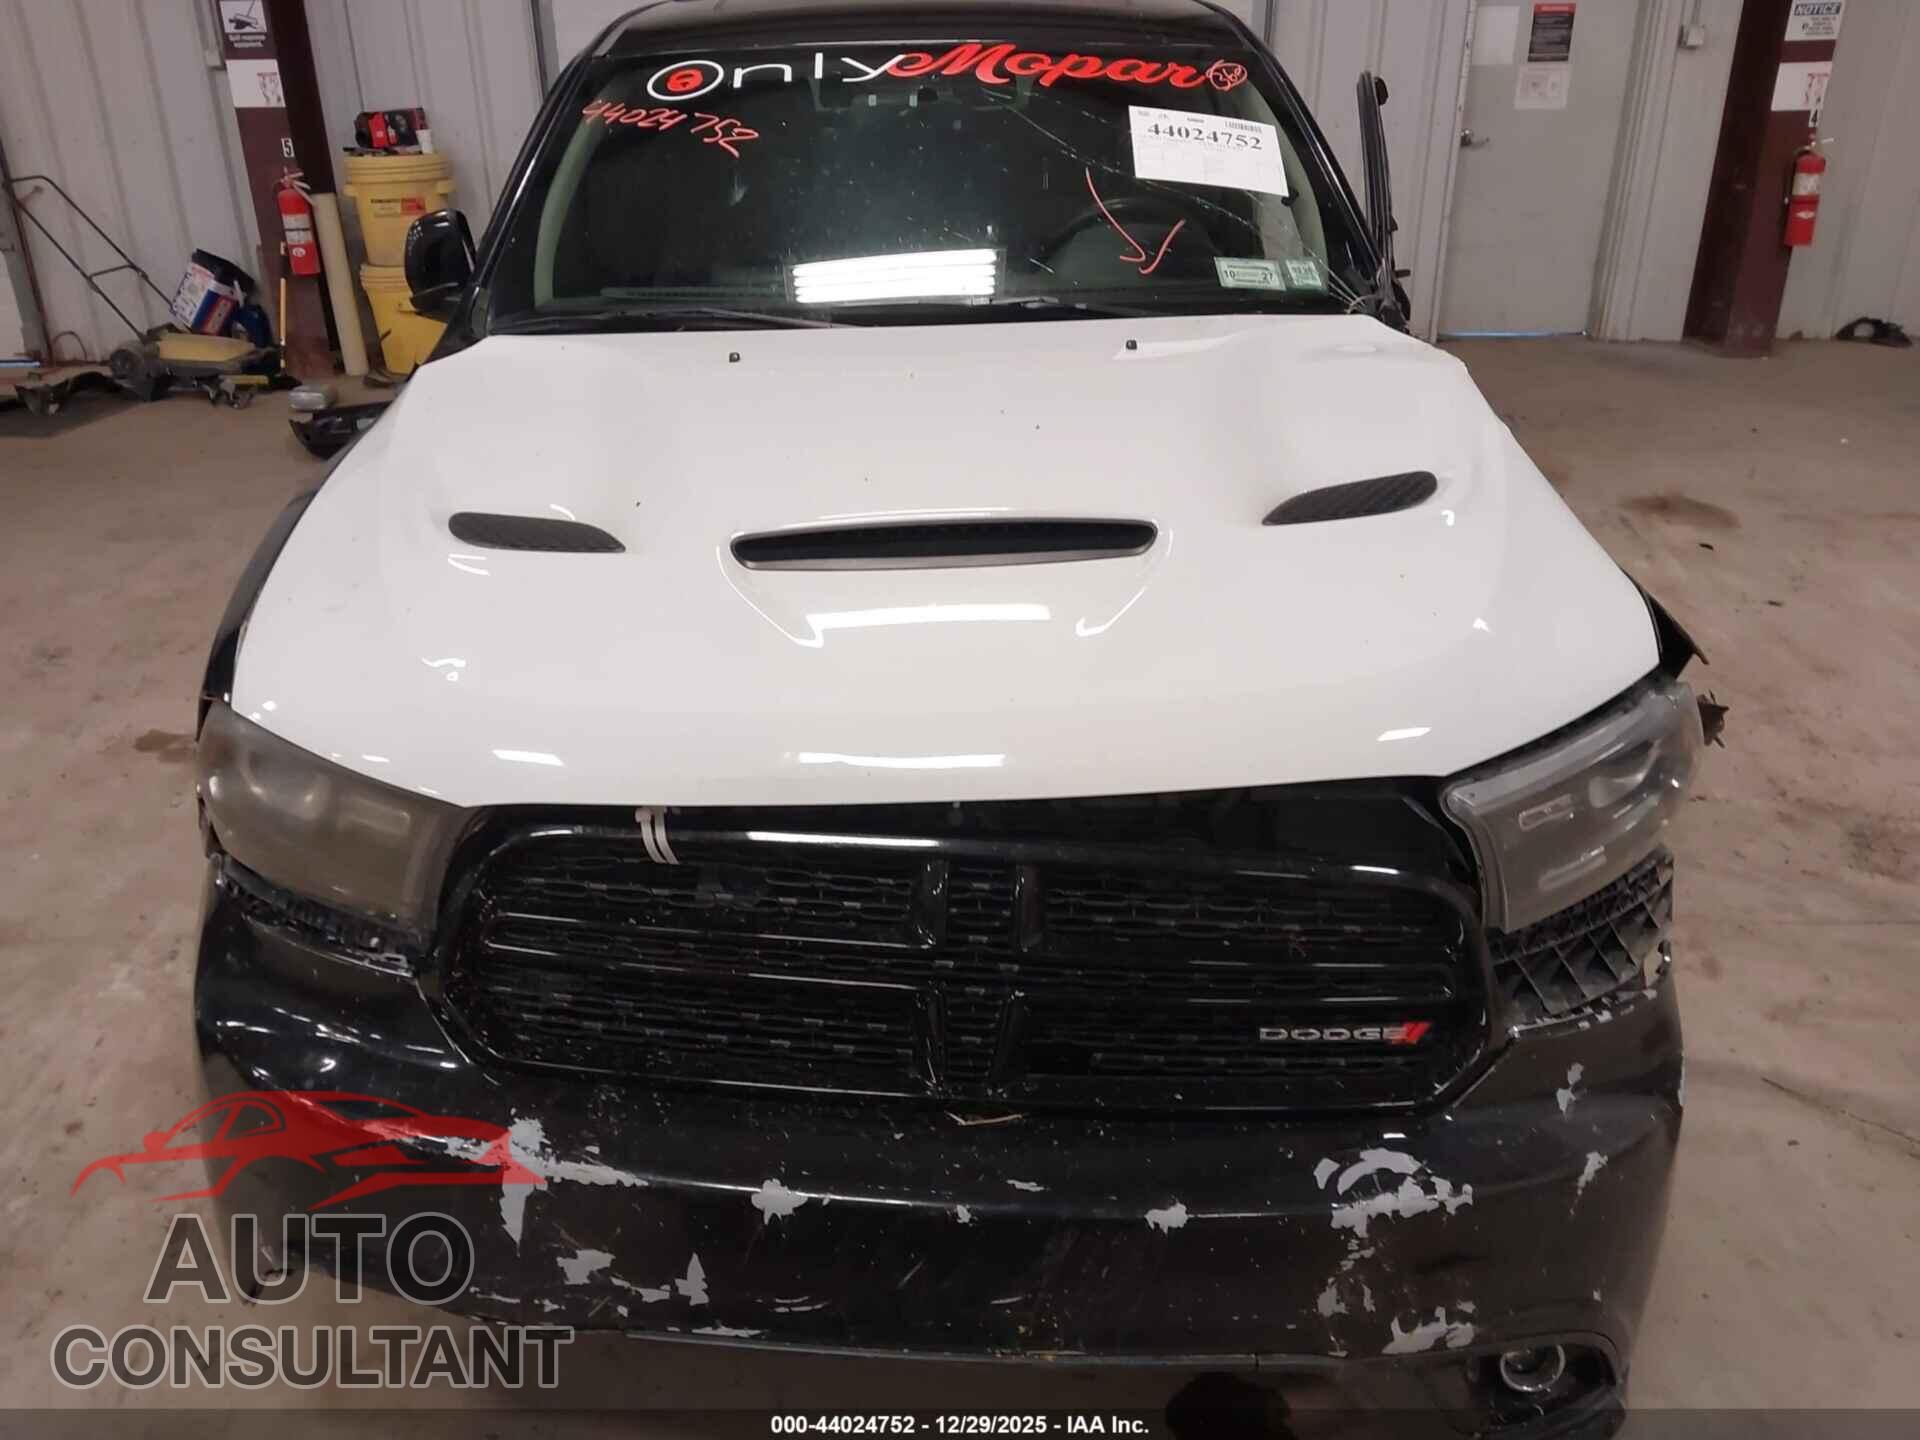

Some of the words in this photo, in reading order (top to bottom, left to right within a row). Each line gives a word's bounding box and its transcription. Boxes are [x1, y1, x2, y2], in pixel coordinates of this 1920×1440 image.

[1795, 3, 1841, 15] NOTICE
[1147, 122, 1263, 151] 44024752
[282, 138, 295, 157] 5
[1259, 1027, 1408, 1041] DODGE
